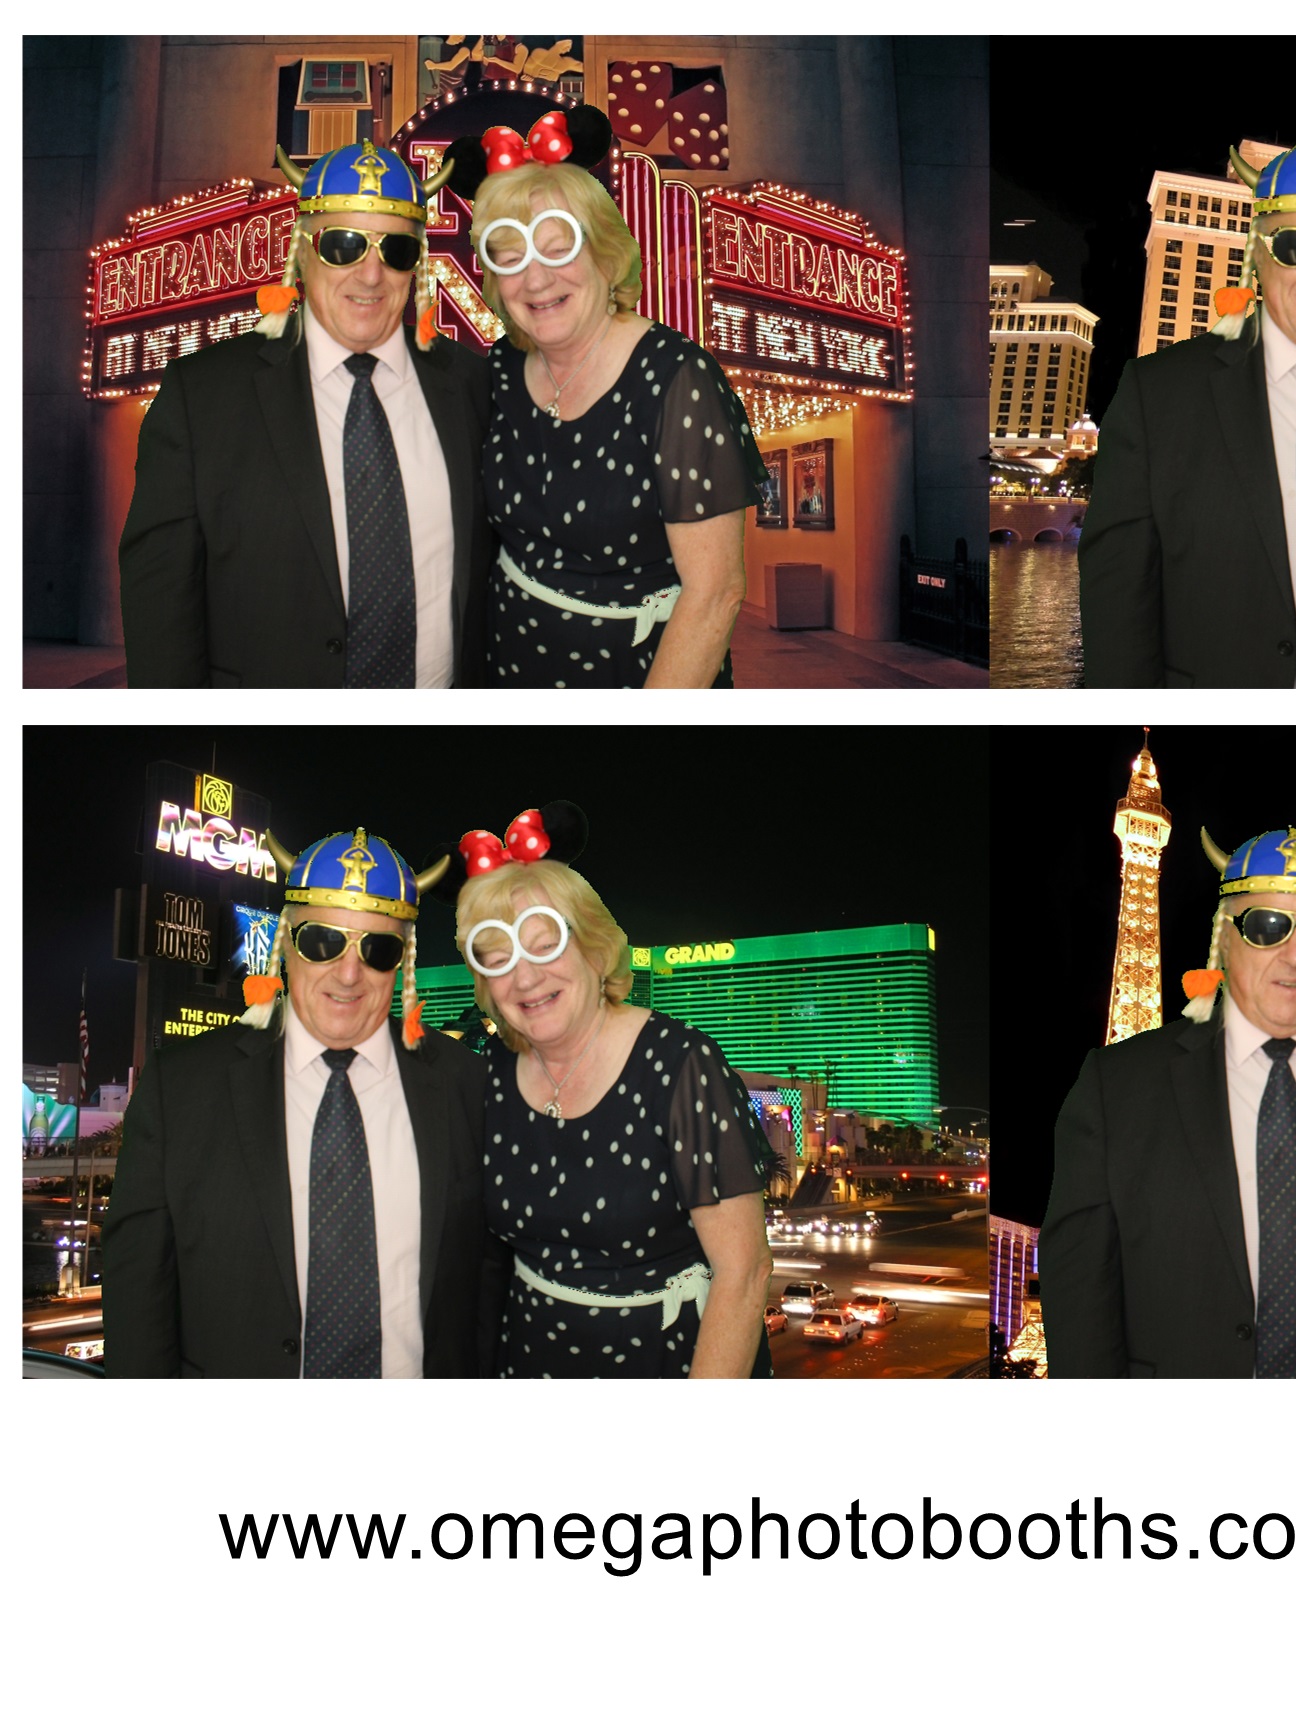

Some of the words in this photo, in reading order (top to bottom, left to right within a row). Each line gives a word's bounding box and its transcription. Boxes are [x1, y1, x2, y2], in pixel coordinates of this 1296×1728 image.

[99, 207, 297, 315] ENTRANCE
[711, 207, 898, 318] ENTRANCE
[754, 311, 819, 367] NEW
[917, 574, 930, 586] EXIT
[930, 576, 946, 589] ONLY
[156, 800, 277, 883] MGM
[164, 892, 204, 930] TOM
[156, 925, 211, 966] JONES
[664, 942, 735, 965] GRAND
[180, 1007, 204, 1025] THE
[205, 1011, 231, 1027] CITY
